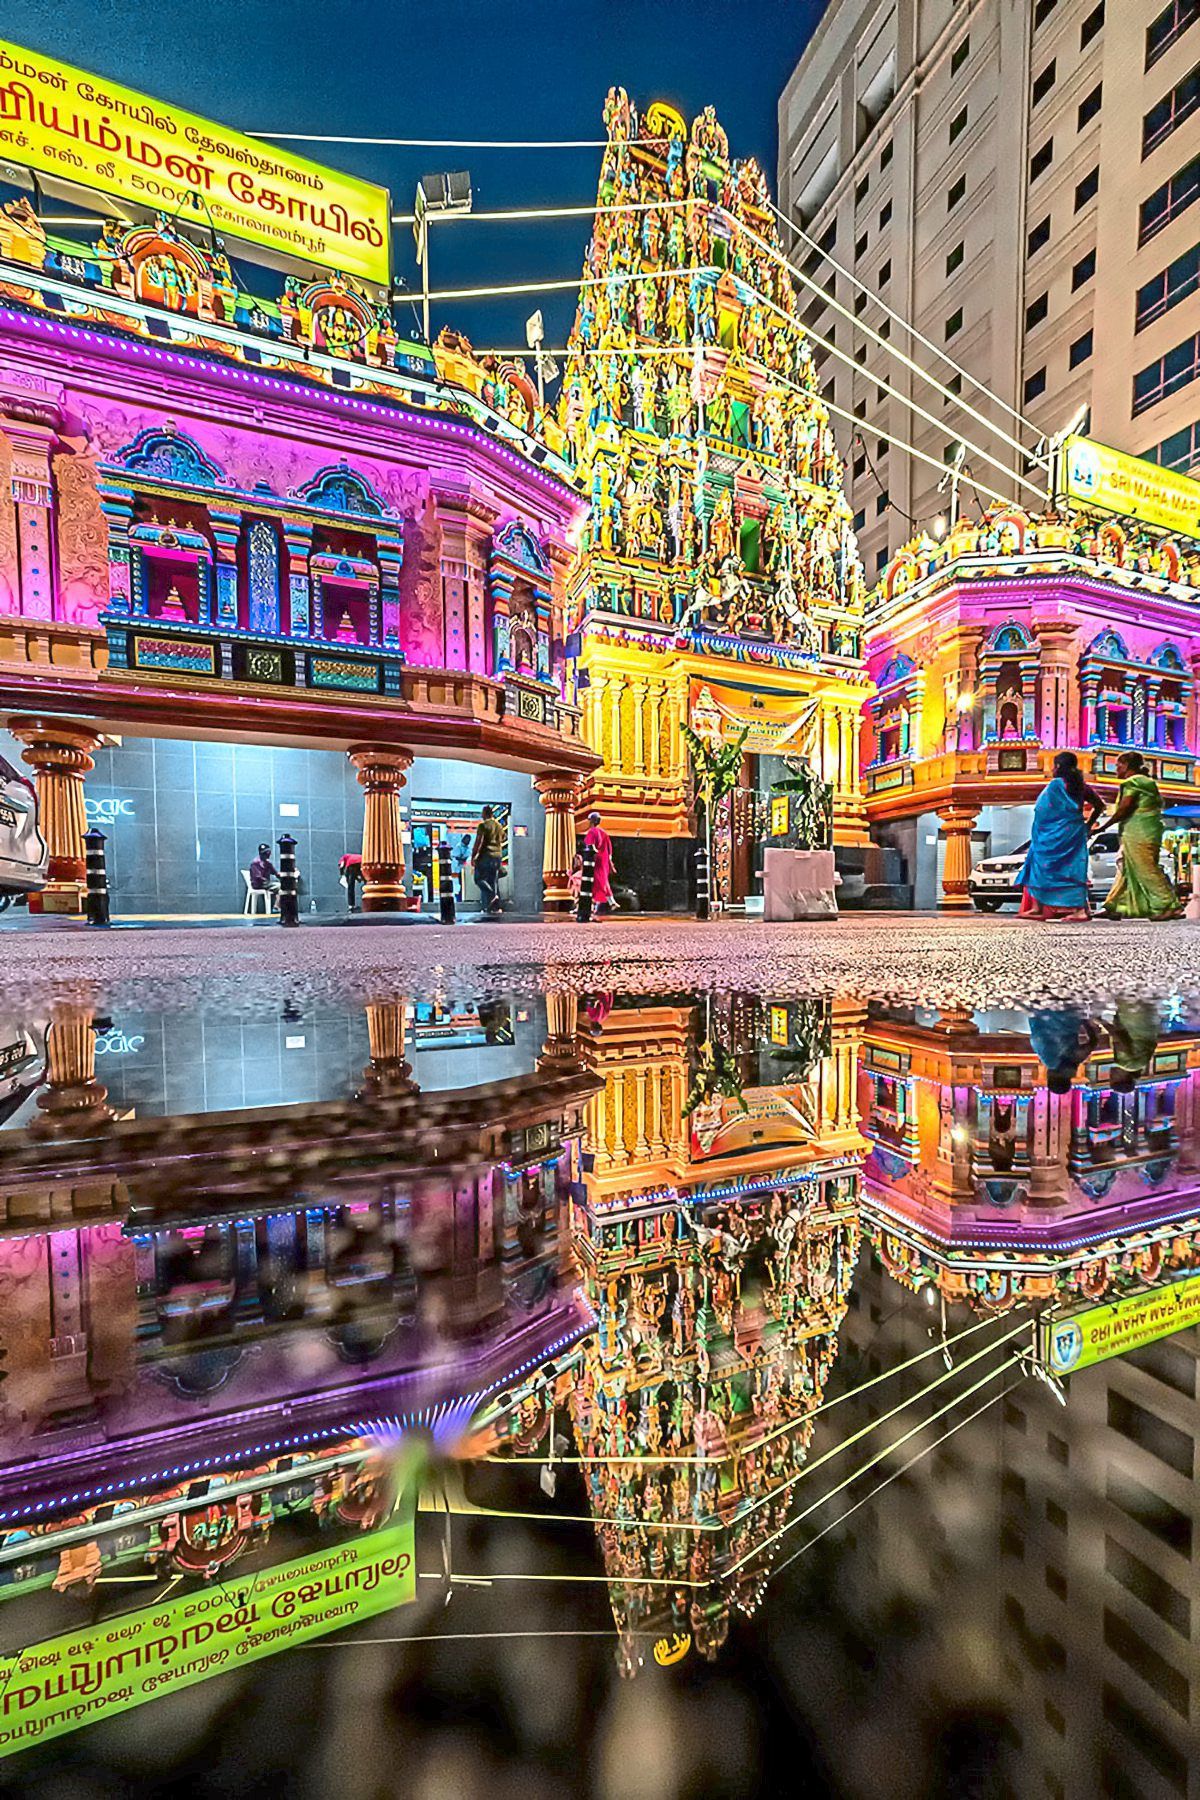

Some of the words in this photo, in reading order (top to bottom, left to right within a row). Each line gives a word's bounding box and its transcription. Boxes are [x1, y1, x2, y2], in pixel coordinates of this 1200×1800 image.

[76, 82, 178, 136] கோயில்
[184, 126, 324, 191] தேவஸ்தானம்
[210, 203, 327, 254] கோலாலம்பூர்
[227, 171, 384, 248] கோயில்
